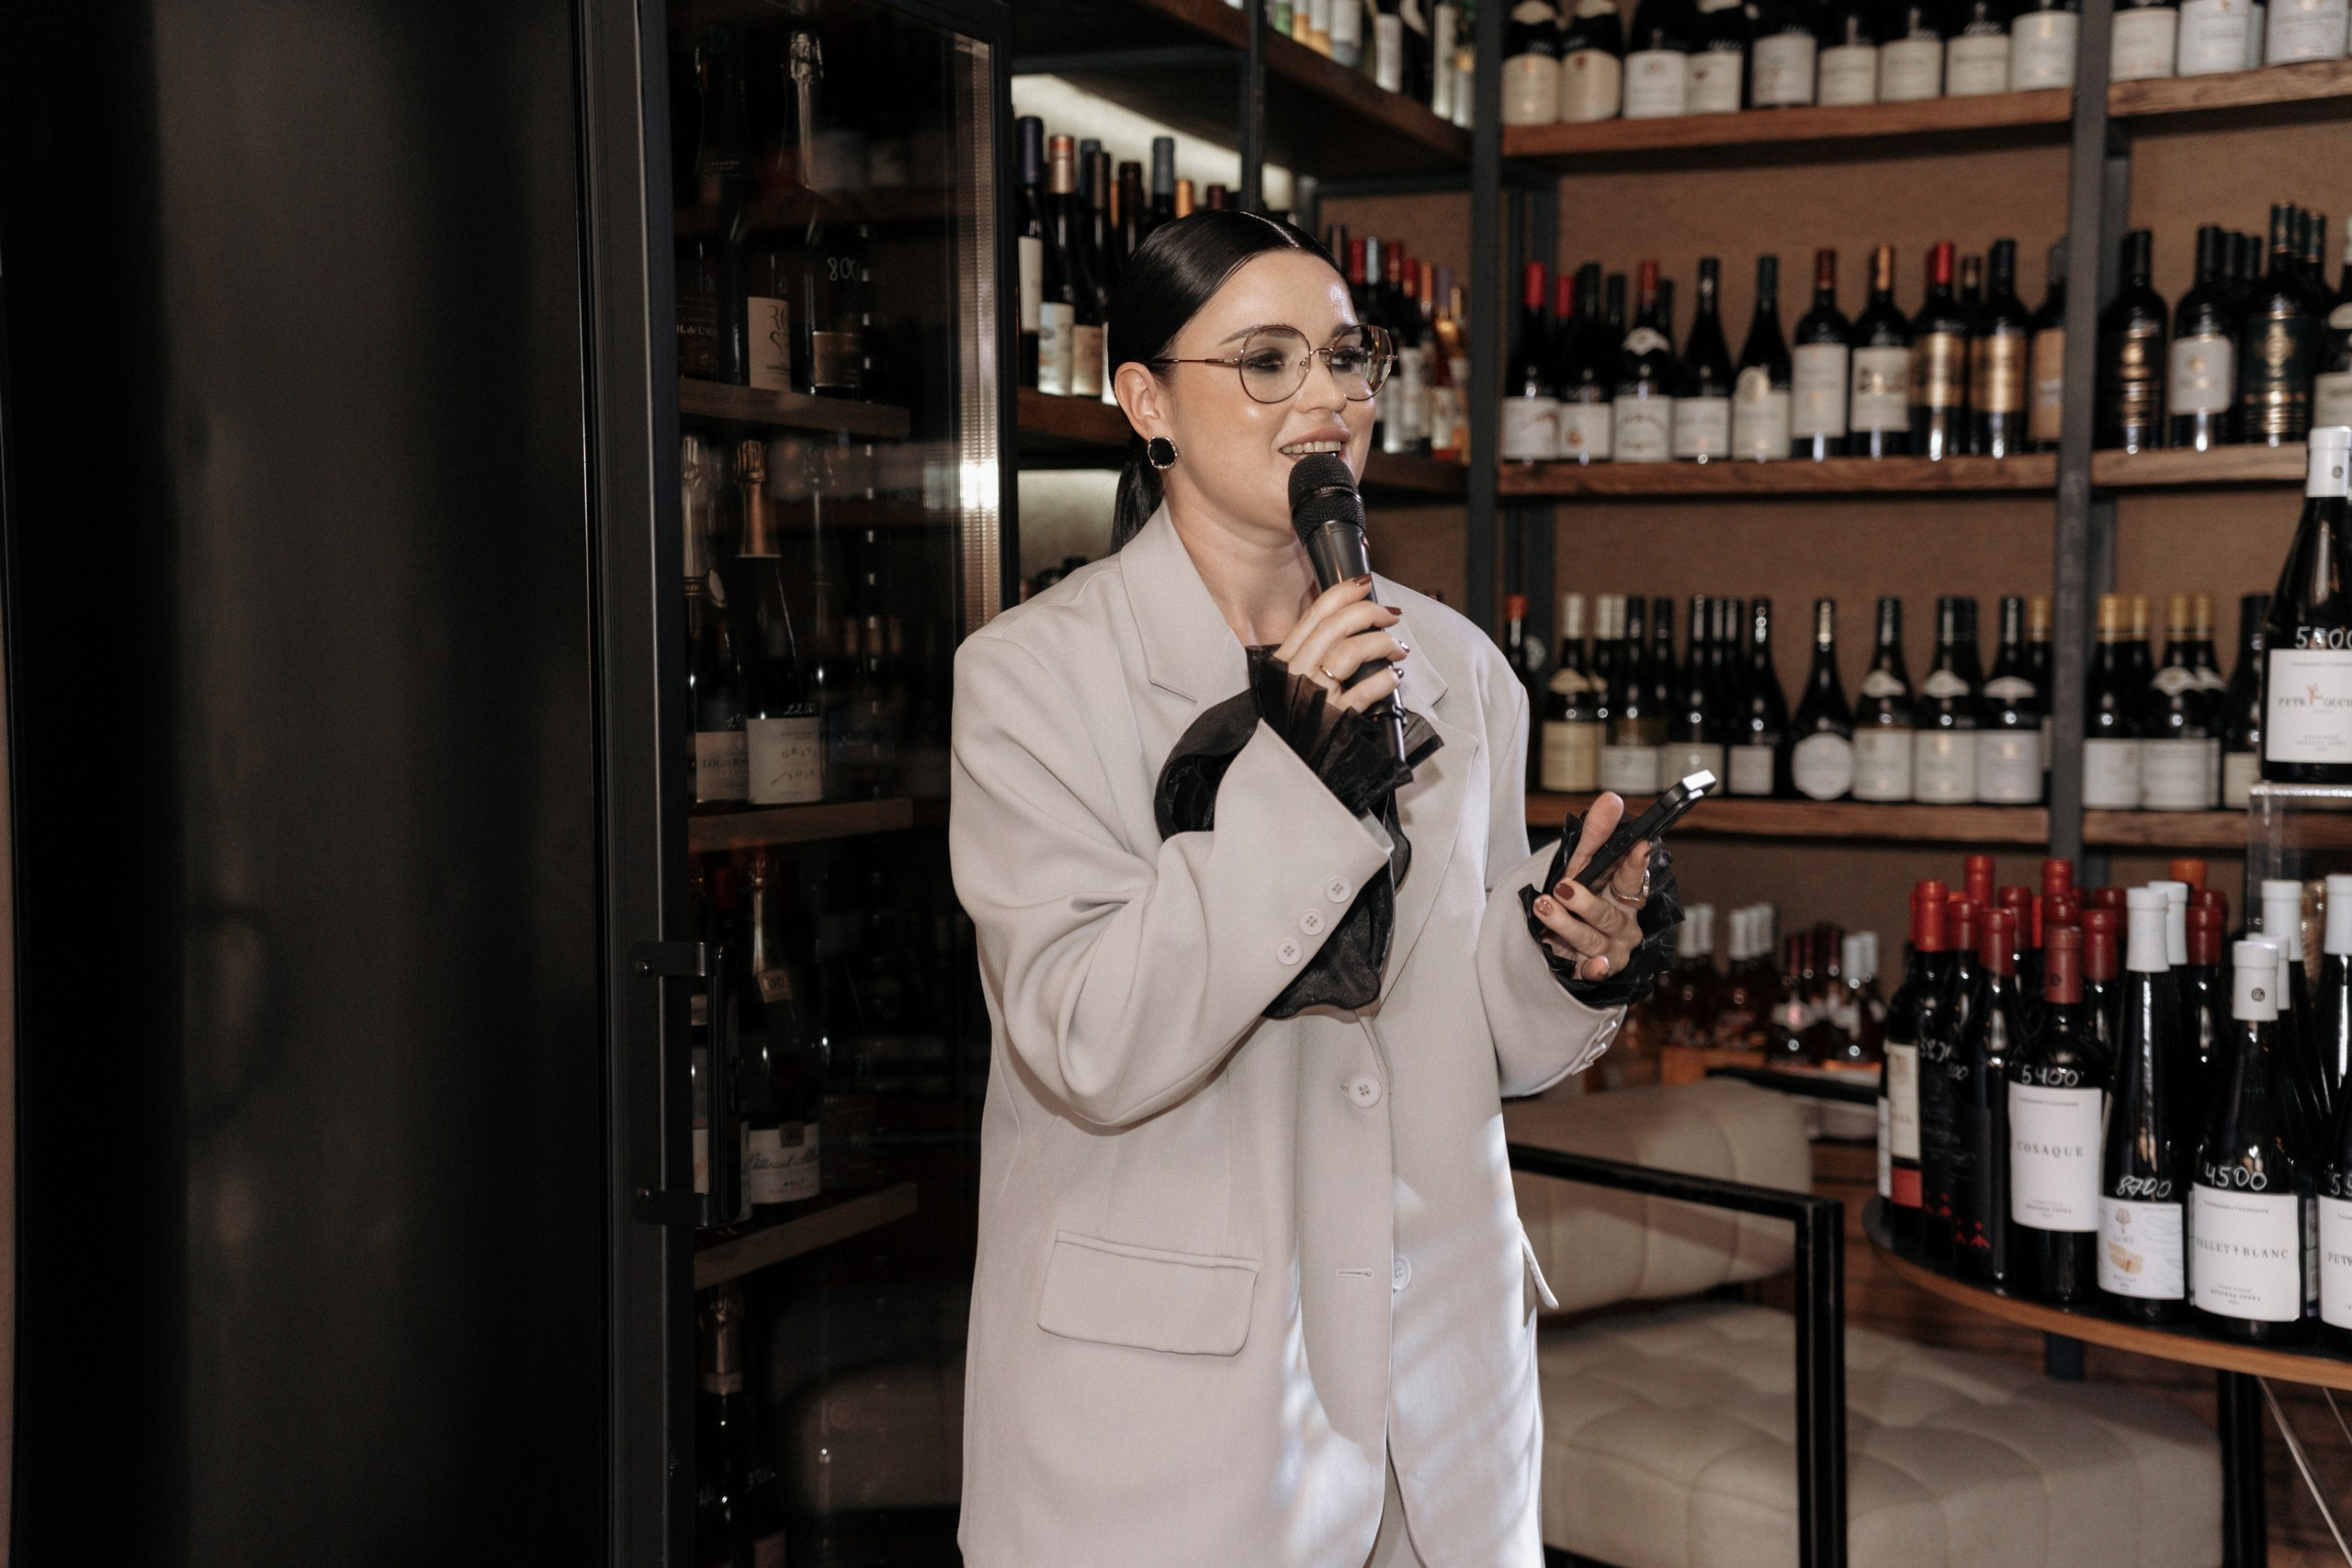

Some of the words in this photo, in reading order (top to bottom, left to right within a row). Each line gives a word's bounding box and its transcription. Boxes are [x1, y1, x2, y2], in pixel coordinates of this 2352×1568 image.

[2020, 1065, 2079, 1088] 5400
[2017, 1141, 2085, 1159] COSAQUE
[2205, 1161, 2267, 1191] 4500
[2243, 1246, 2289, 1259] BLANC
